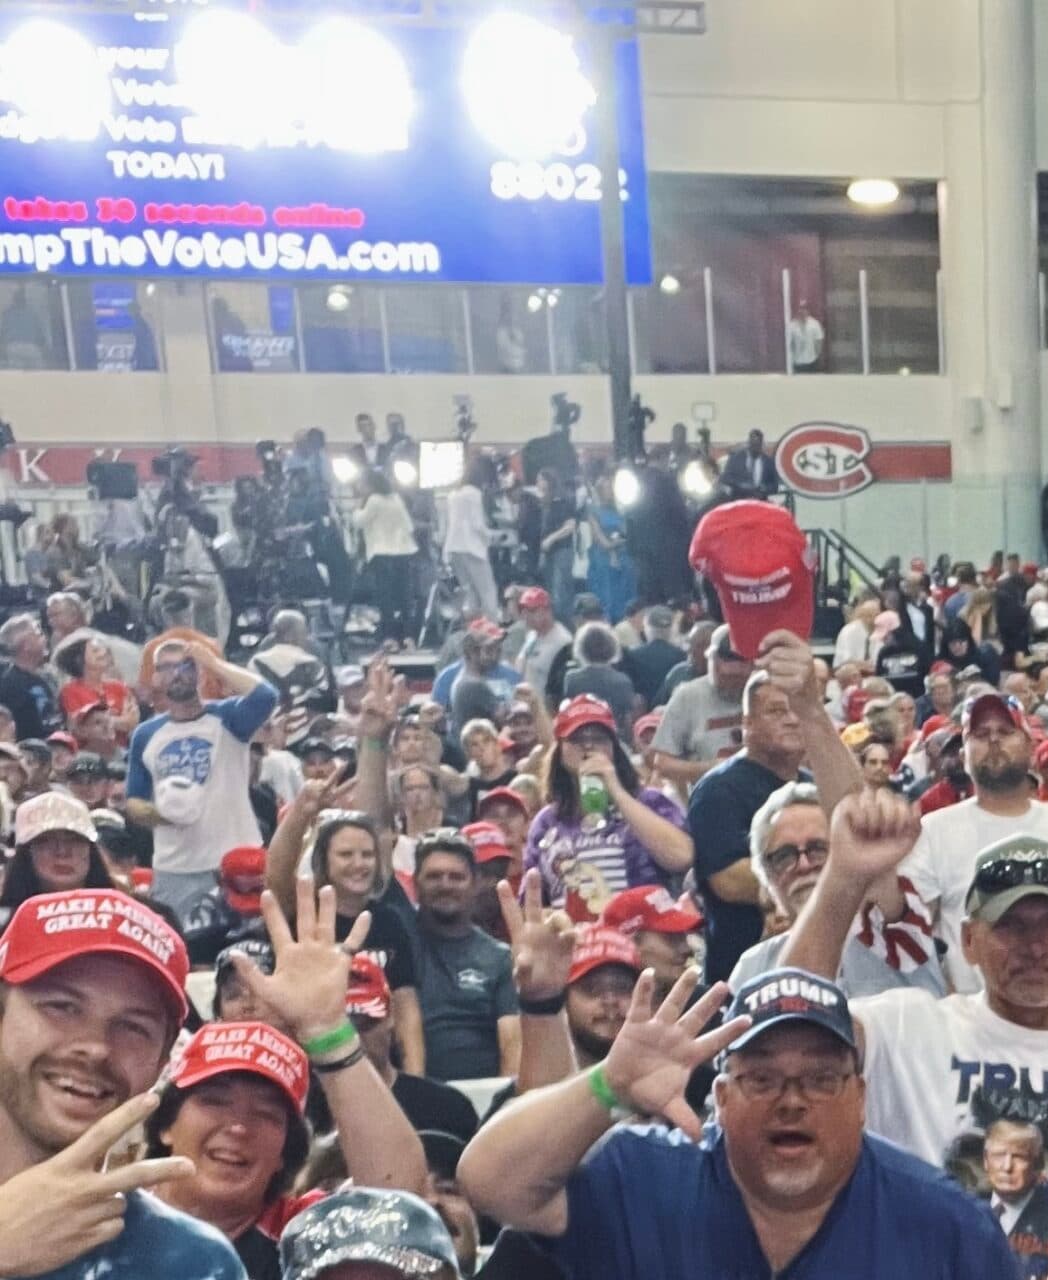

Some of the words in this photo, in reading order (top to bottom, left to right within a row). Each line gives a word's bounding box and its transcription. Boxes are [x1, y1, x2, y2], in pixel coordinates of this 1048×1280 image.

[106, 150, 226, 181] TODAY!
[37, 898, 96, 920] MAKE
[44, 914, 113, 935] GREAT
[117, 919, 171, 965] AGAIN
[744, 978, 839, 1011] TRUMP
